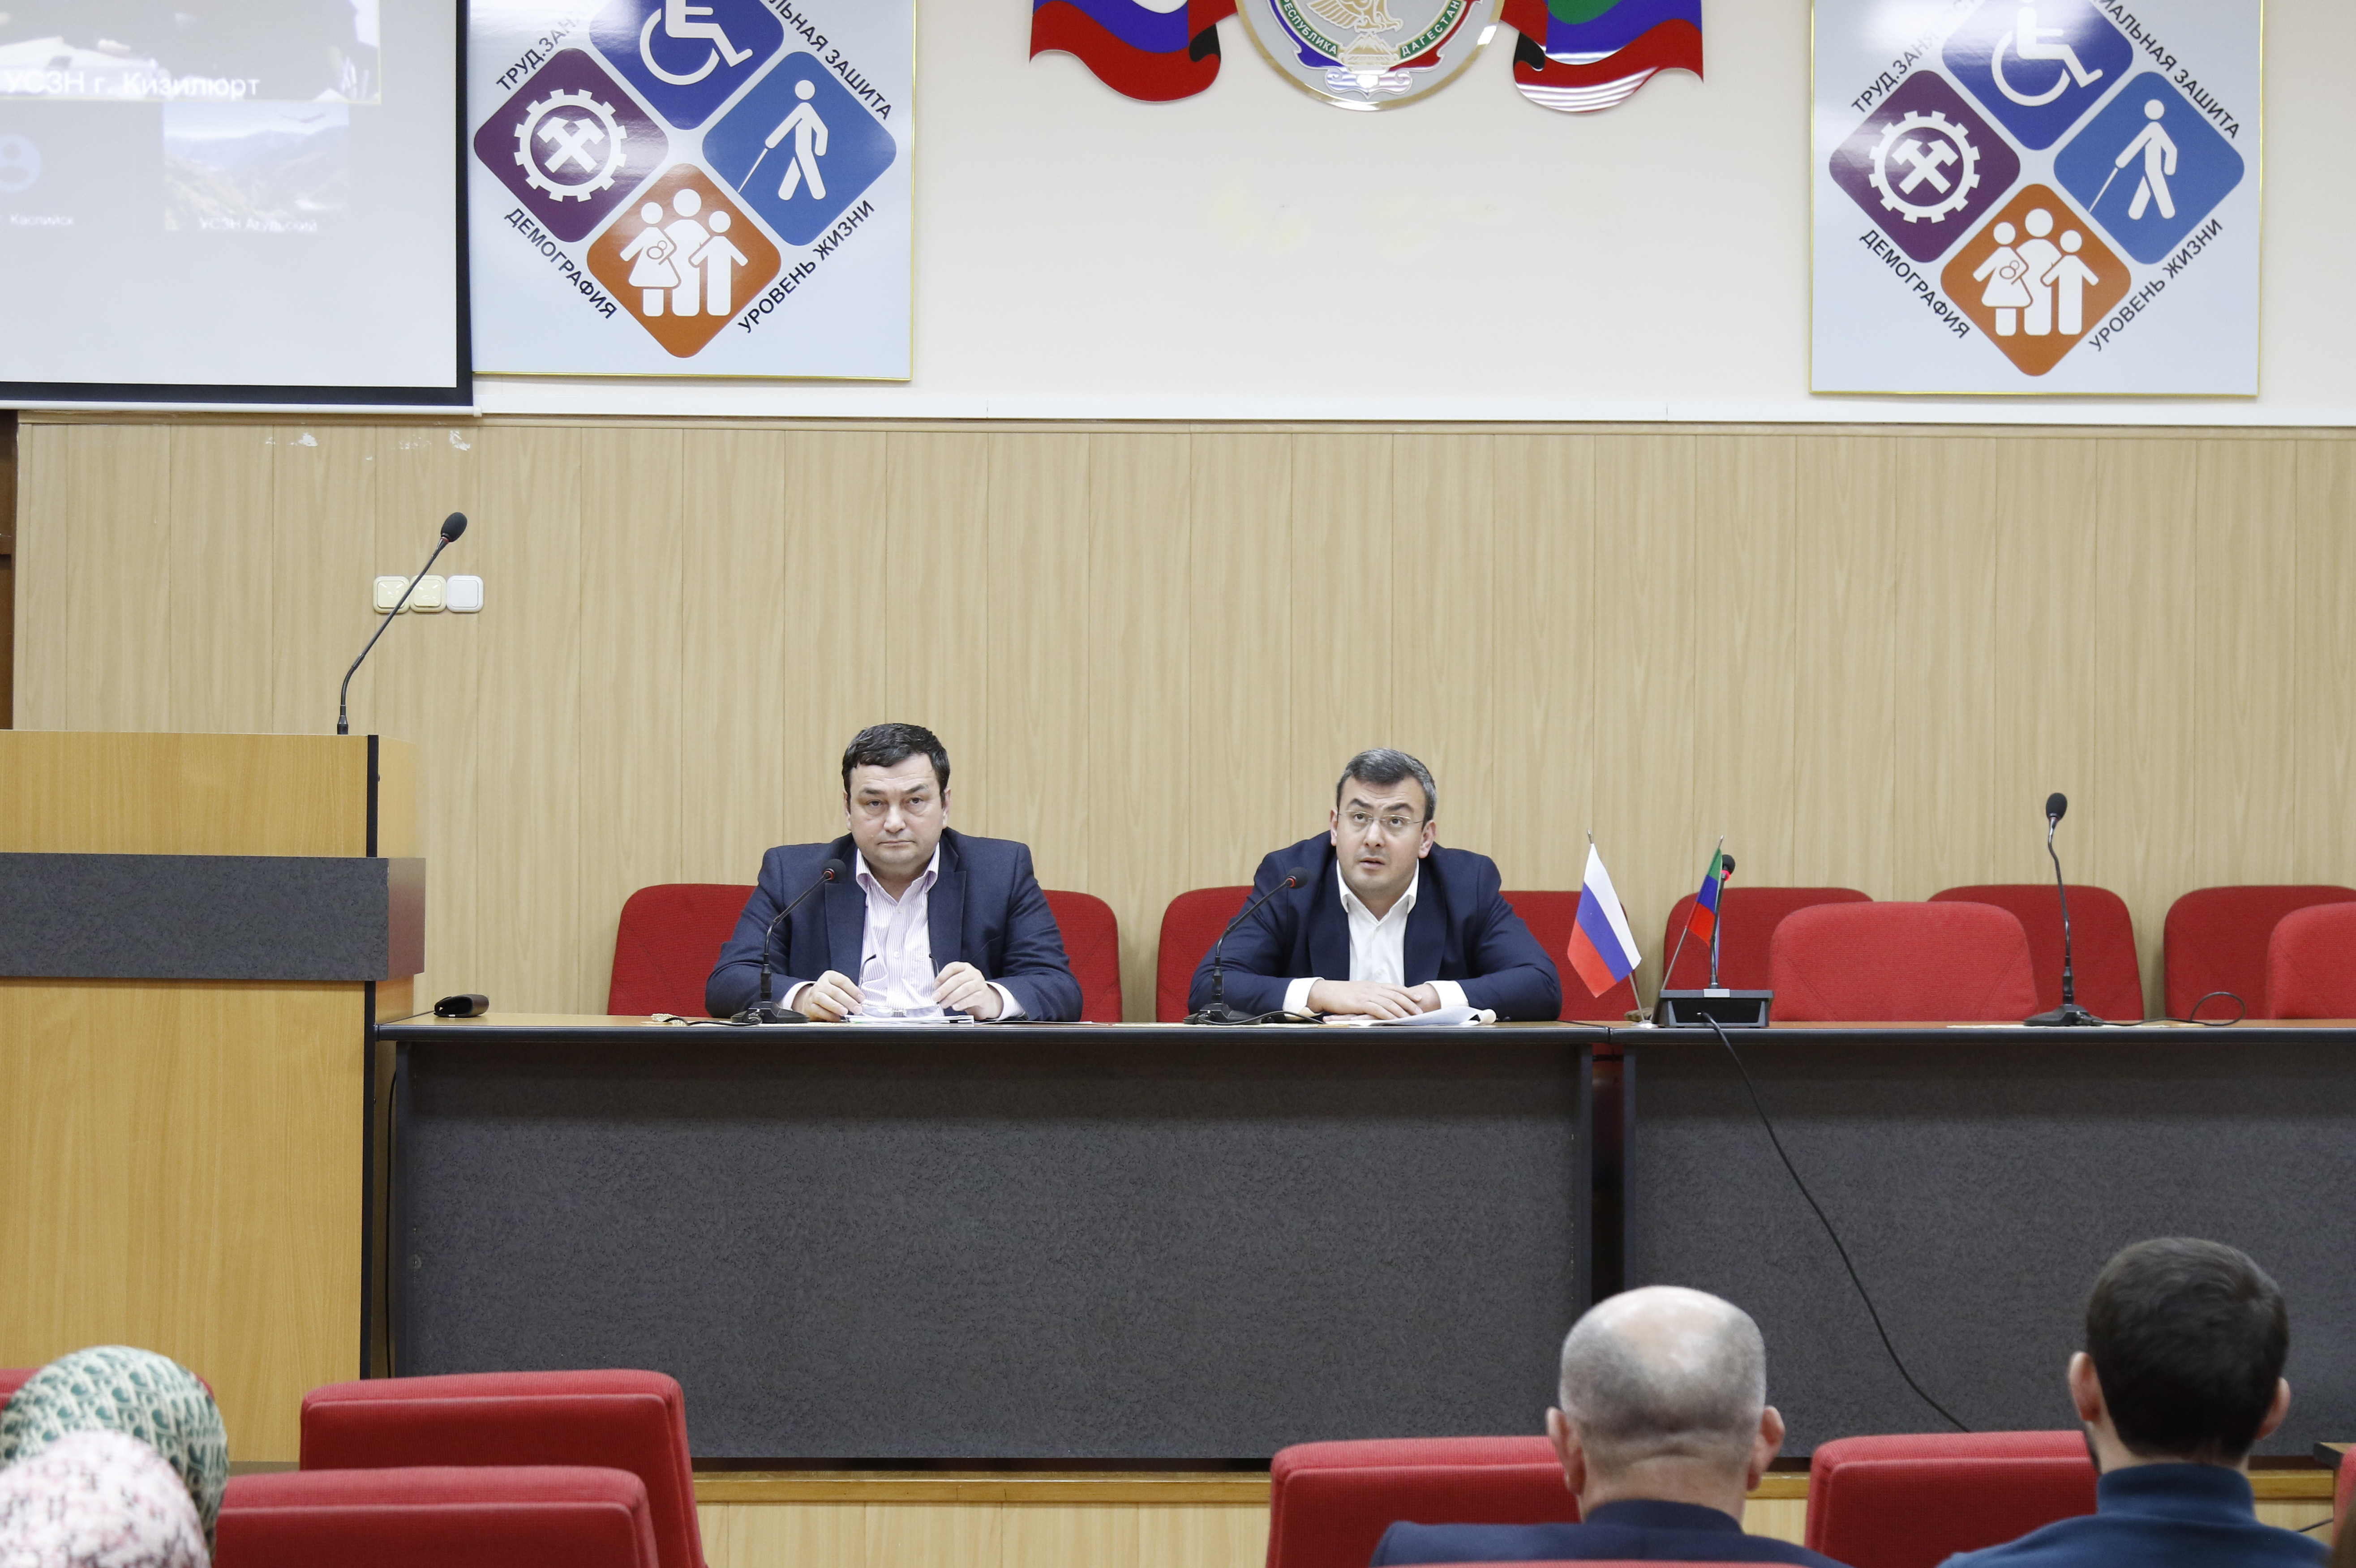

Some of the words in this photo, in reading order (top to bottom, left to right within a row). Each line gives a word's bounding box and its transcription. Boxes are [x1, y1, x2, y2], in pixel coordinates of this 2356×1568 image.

[496, 16, 581, 91] ТРУД.ЗАН
[768, 0, 828, 52] ЛЬНАЯ
[1402, 0, 1460, 57] ДАГЕСТАН
[2097, 0, 2177, 72] ИАЛЬНАЯ
[6, 71, 84, 94] УСЗН
[123, 72, 261, 100] Кизилюрт
[10, 213, 74, 226] Каспийск
[504, 208, 618, 319] ДЕМОГРАФИЯ
[737, 261, 816, 334] УРОВЕНЬ
[812, 200, 875, 261] ЖИЗНИ
[1859, 229, 1970, 339] ДЕМОГРАФИЯ
[2088, 279, 2166, 352] УРОВЕНЬ
[2162, 218, 2223, 279] ЖИЗНИ
